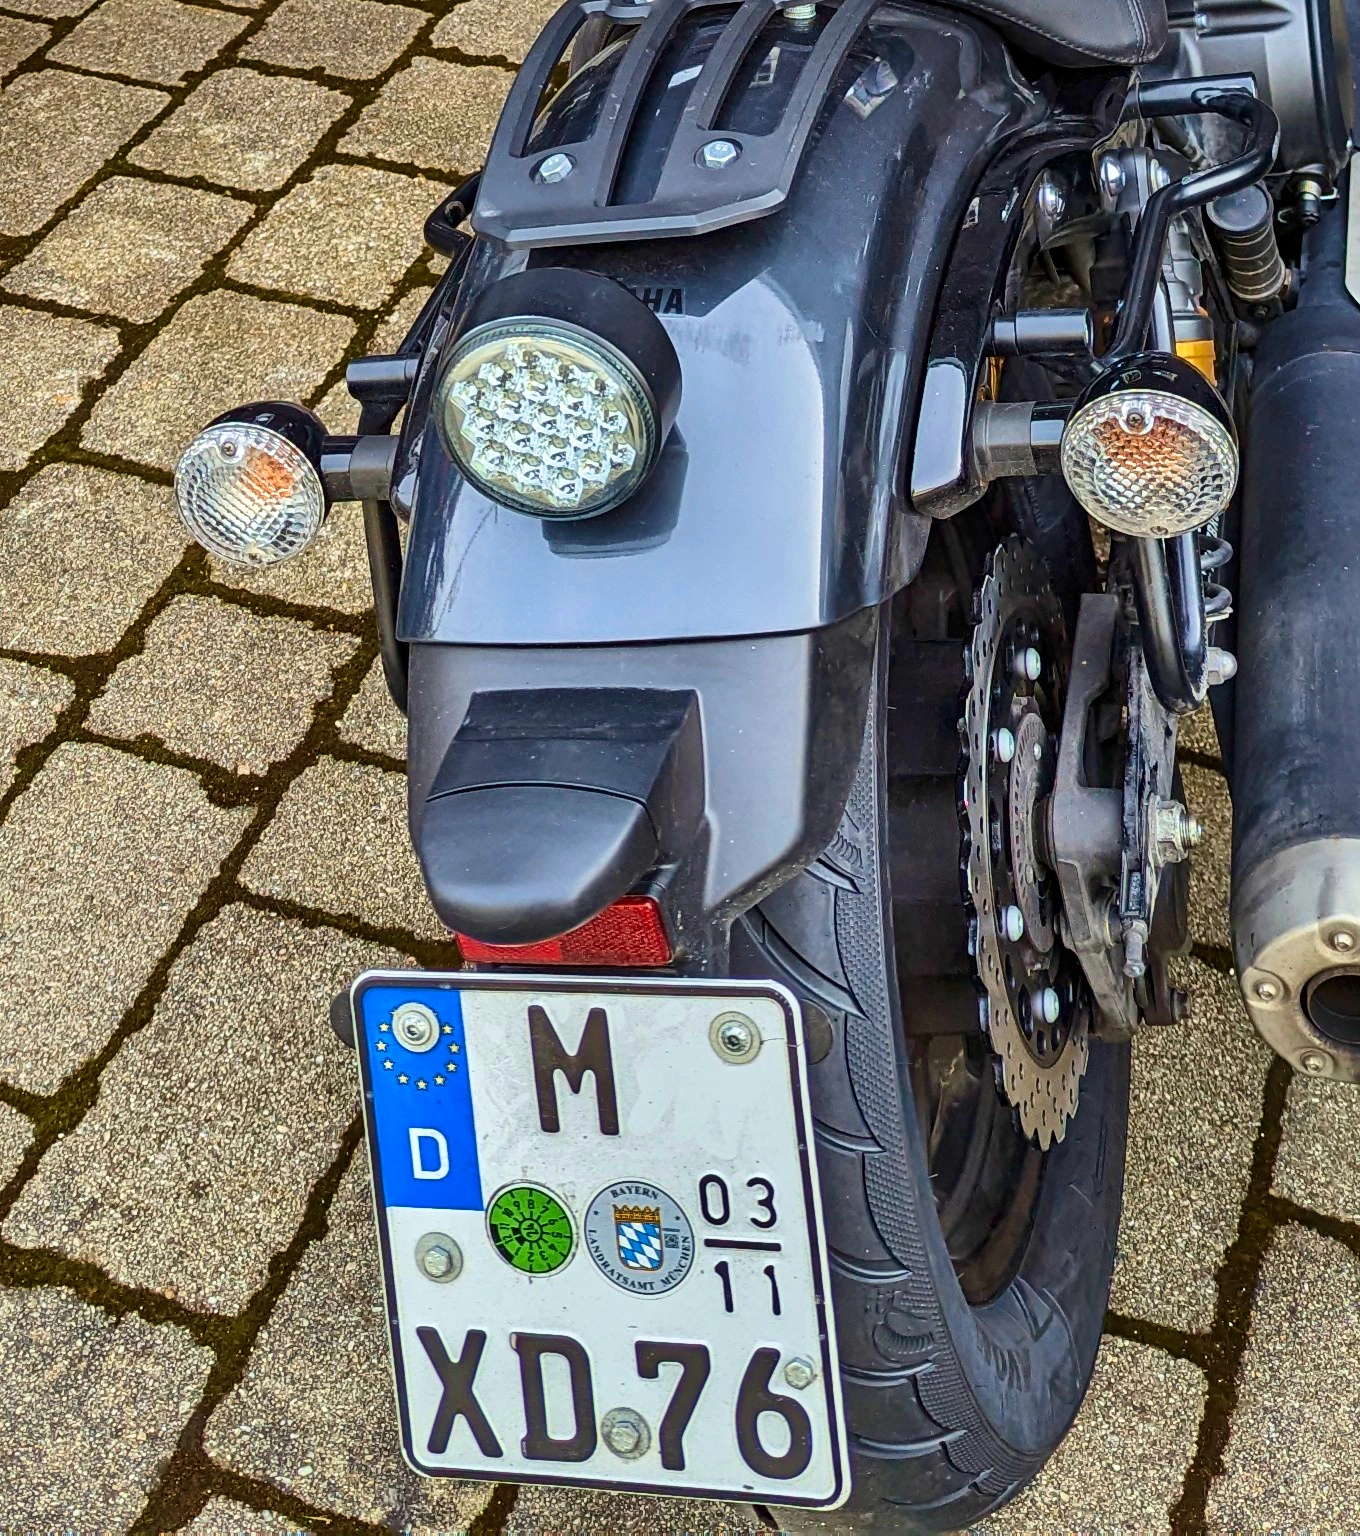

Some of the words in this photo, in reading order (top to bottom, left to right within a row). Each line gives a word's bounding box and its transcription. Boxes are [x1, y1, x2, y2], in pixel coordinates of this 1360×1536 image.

[528, 1004, 621, 1136] M
[408, 1127, 451, 1181] D
[610, 1185, 659, 1200] BAYERN
[698, 1172, 778, 1231] 03
[588, 1229, 655, 1291] LANDRATSAMT
[660, 1235, 691, 1288] MÜNCHEN
[714, 1260, 781, 1316] 11
[416, 1326, 598, 1463] XD
[634, 1340, 813, 1480] 76
